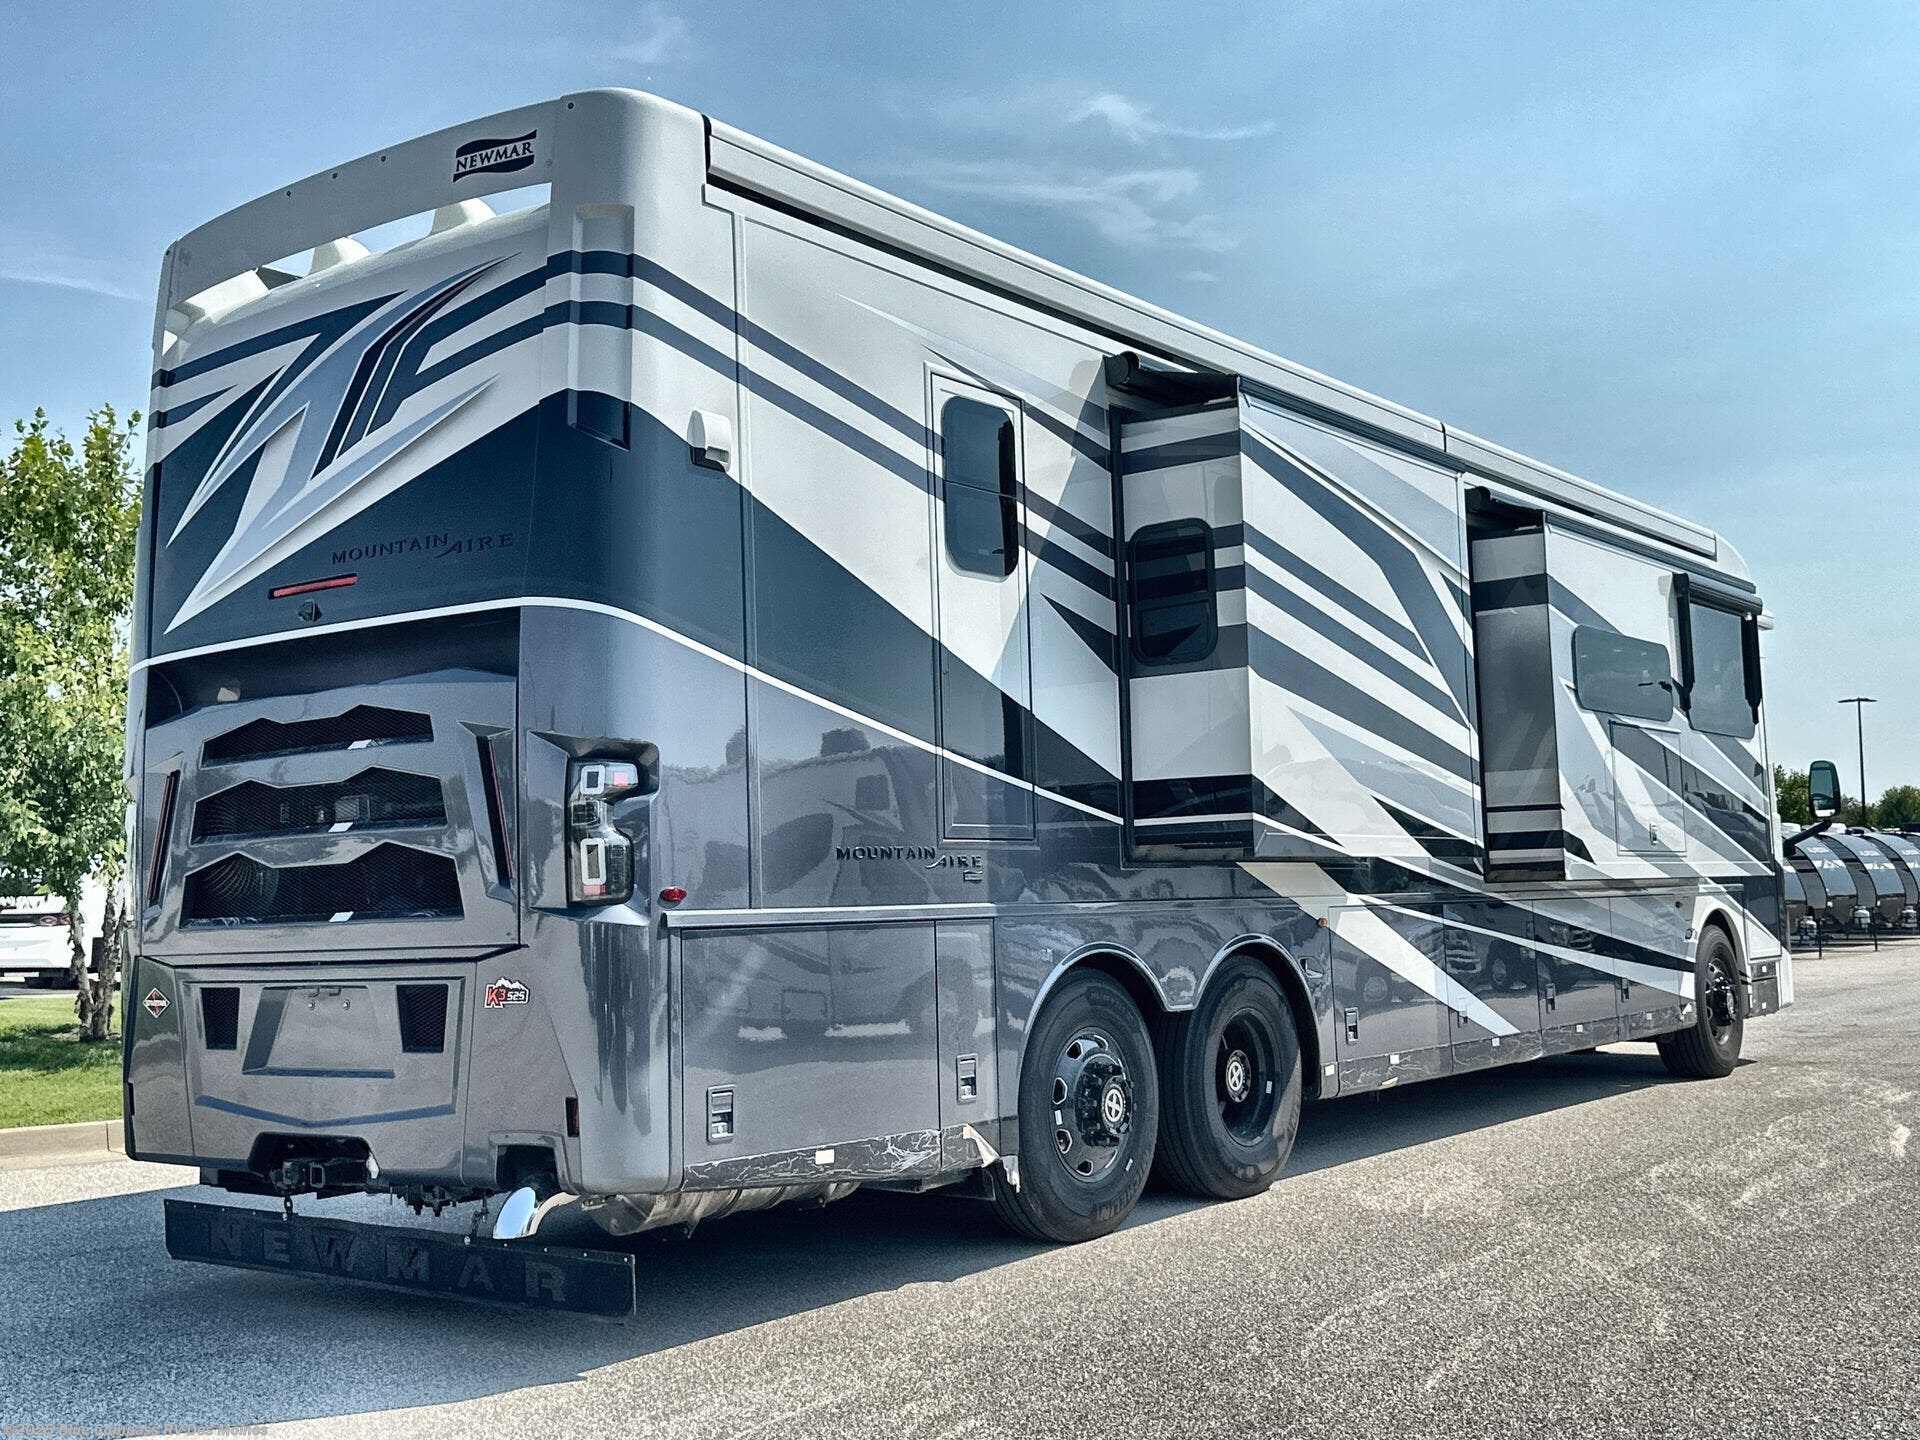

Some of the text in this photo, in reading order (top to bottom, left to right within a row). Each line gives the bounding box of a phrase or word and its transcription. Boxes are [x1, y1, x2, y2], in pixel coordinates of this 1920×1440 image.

[456, 141, 533, 172] NEWMAR
[332, 533, 514, 565] MOUNTAIN AIRE
[836, 846, 982, 869] MOUNTAIN AIRE
[207, 1219, 566, 1302] NEWMAR
